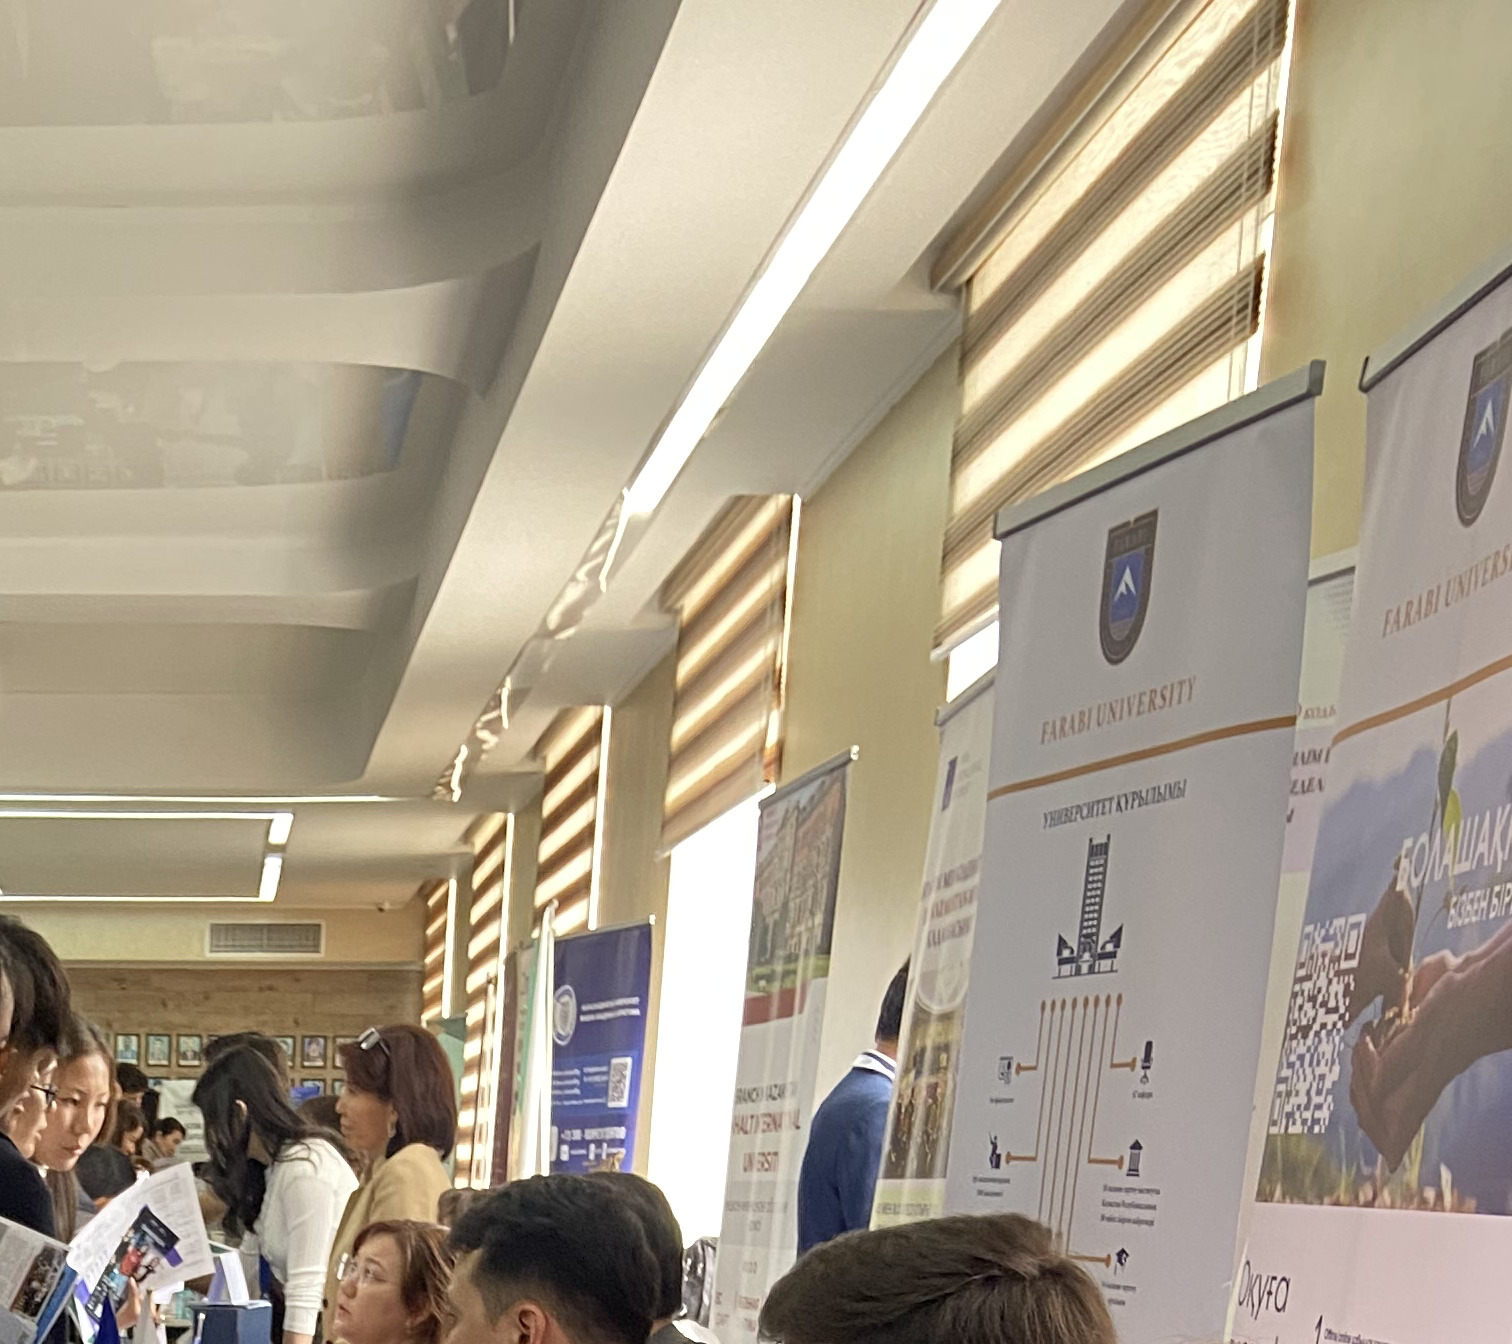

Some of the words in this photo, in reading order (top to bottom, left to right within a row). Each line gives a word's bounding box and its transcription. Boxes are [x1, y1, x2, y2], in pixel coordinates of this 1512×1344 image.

[1382, 585, 1441, 637] FARABI
[1041, 708, 1093, 745] FARABI
[1096, 676, 1196, 727] UNIVERSITY
[1043, 795, 1114, 829] УНИВЕРСИТЕТ
